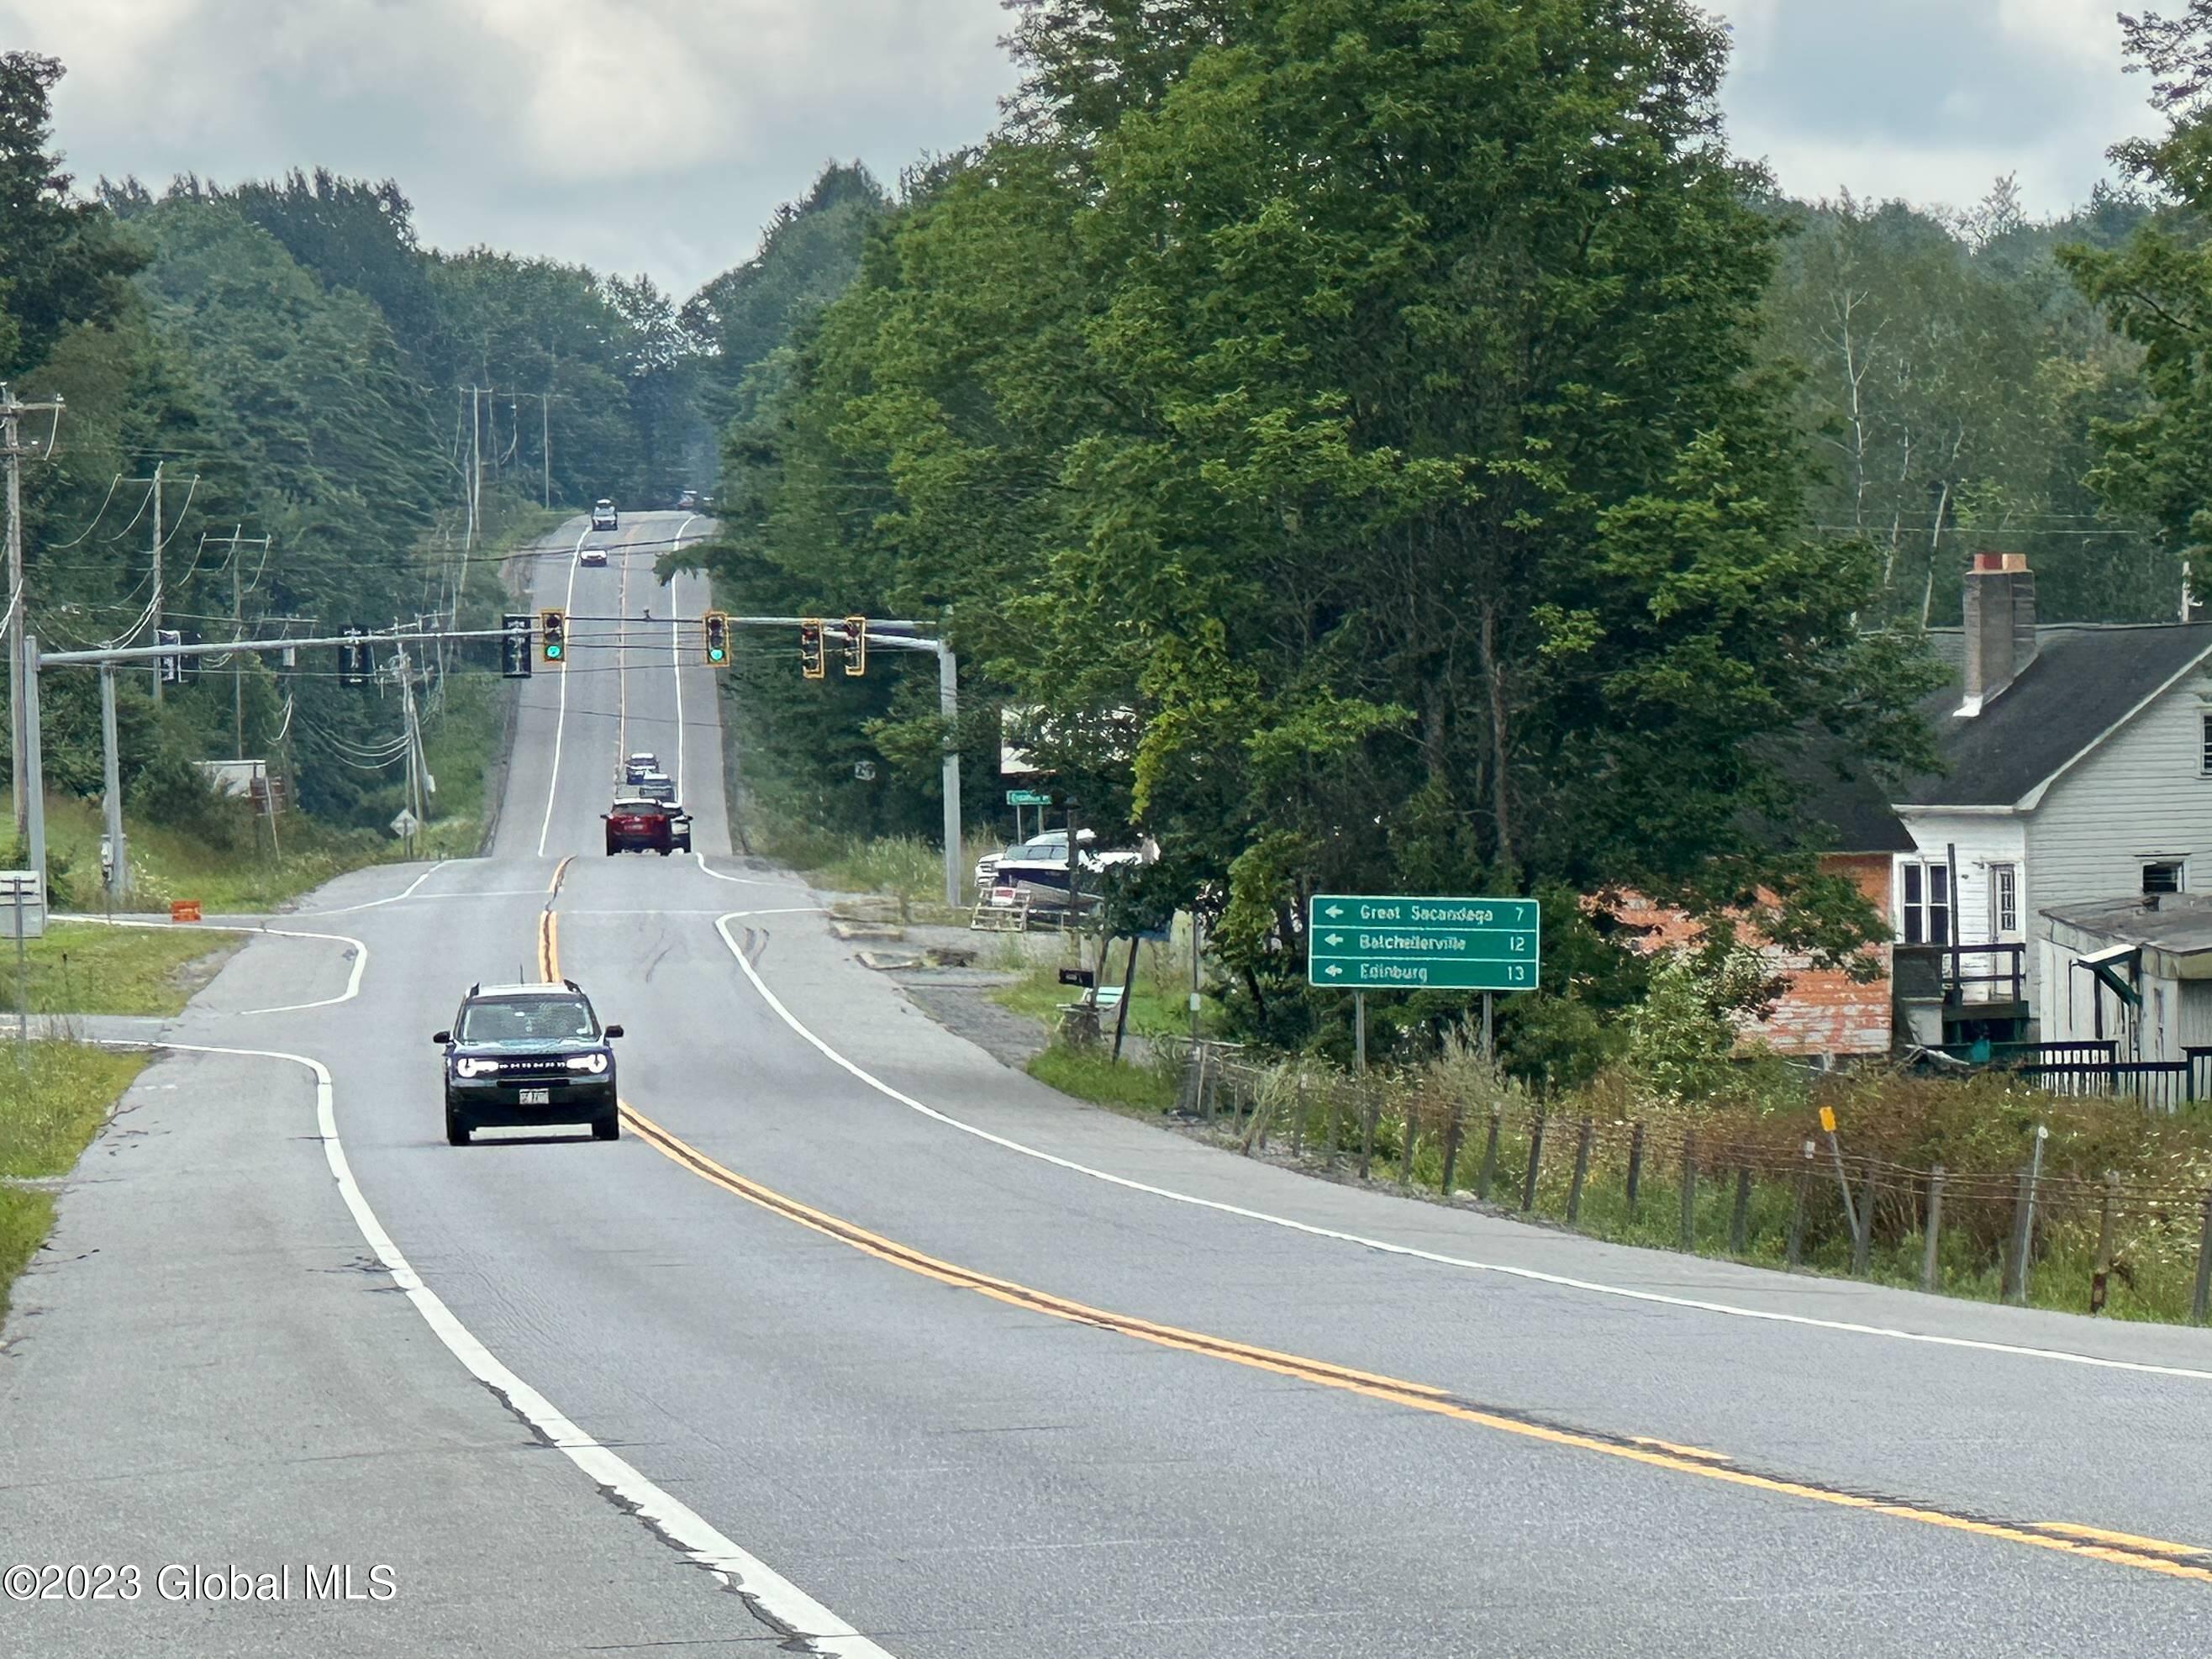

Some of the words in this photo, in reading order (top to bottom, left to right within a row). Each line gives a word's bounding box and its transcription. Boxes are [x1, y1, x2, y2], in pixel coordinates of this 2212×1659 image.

[1360, 904, 1401, 920] Great
[1515, 907, 1525, 922] 7
[1510, 936, 1525, 951] 12
[1508, 967, 1525, 981] 13
